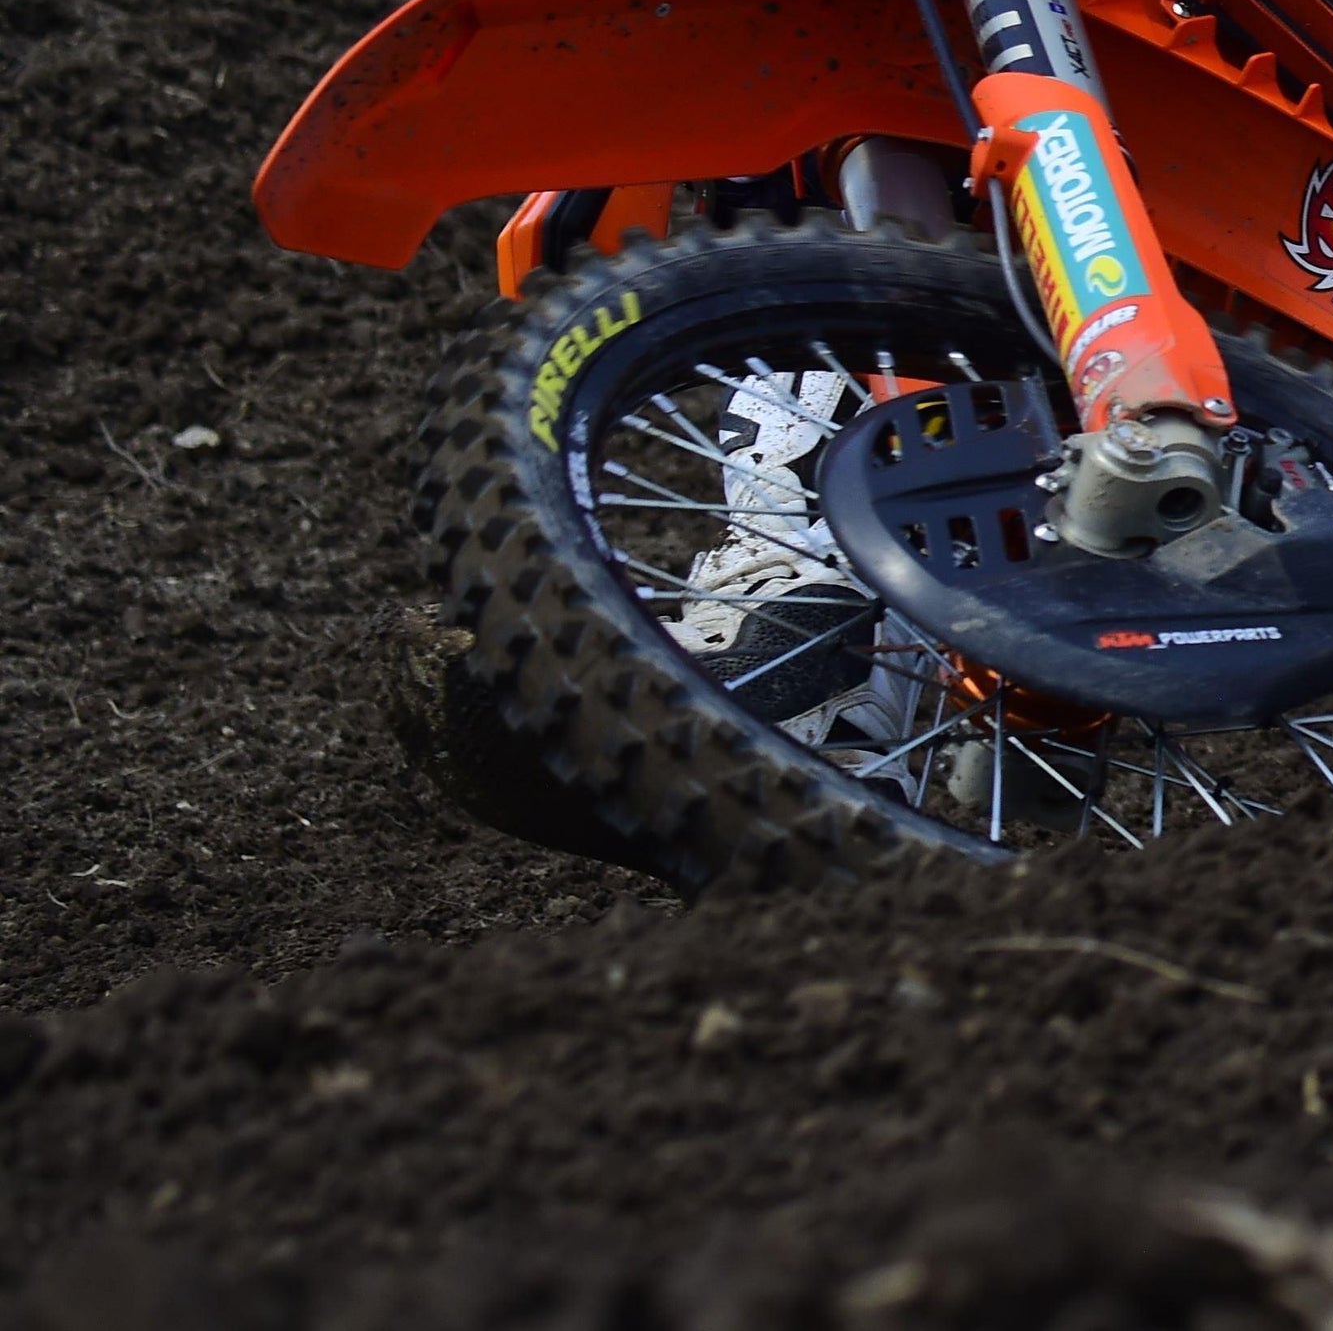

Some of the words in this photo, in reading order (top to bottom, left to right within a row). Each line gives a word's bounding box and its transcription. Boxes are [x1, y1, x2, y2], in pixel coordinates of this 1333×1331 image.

[1035, 114, 1115, 263] MOTOREX
[530, 291, 642, 453] PIRELLI
[1158, 626, 1283, 645] POWERPARTS
